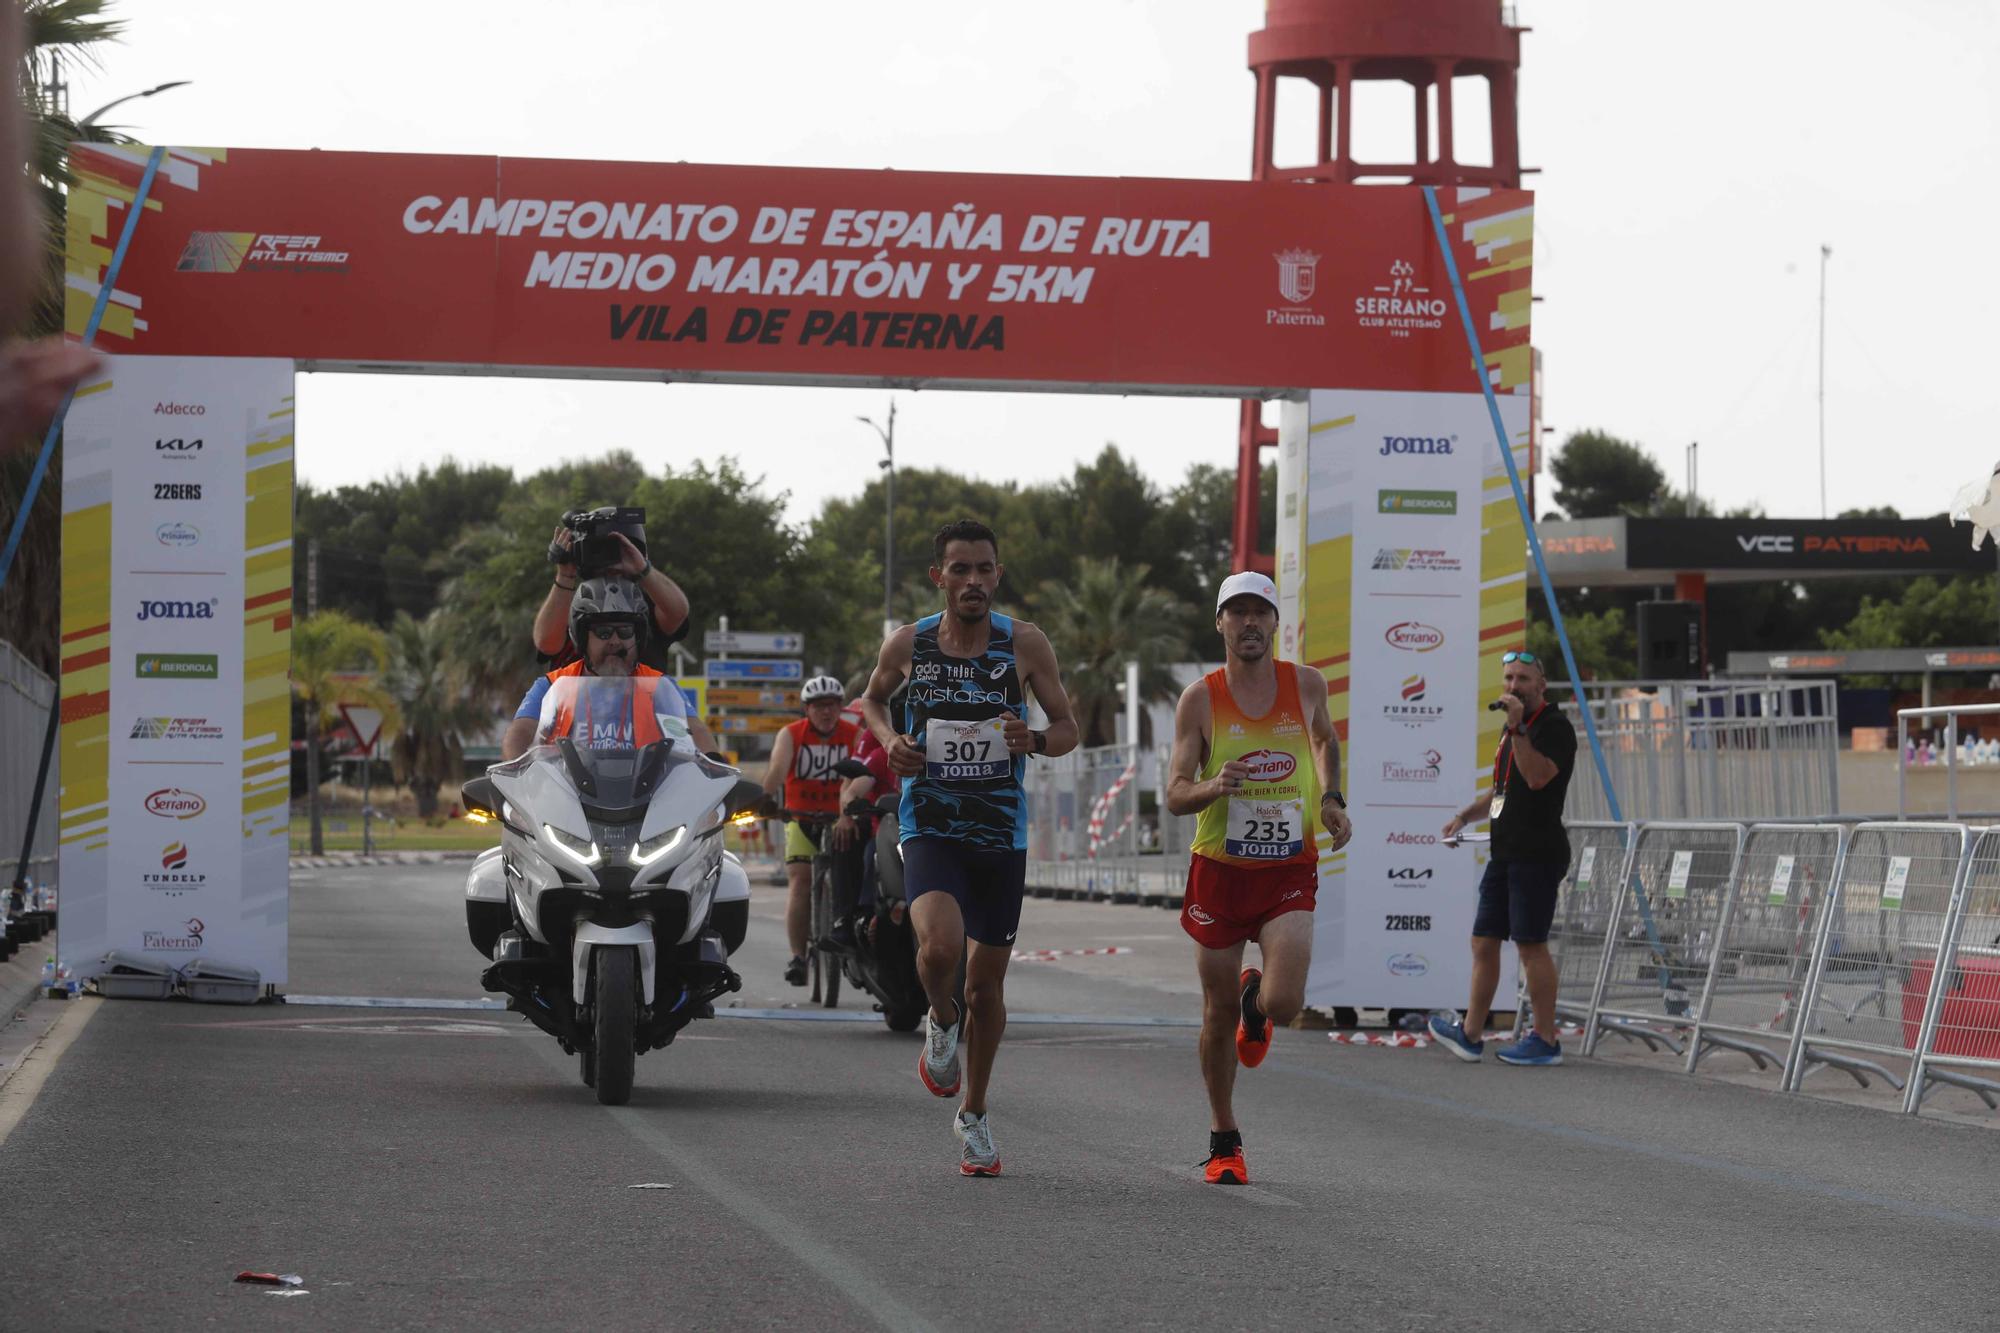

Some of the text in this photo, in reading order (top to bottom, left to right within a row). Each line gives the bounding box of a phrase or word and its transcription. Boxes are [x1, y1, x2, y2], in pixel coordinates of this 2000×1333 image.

[402, 195, 1210, 258] CAMPEONATO DE ESPAÑA DE RUTA
[249, 251, 349, 263] ATLETISMO
[524, 251, 1095, 304] MEDIO MARATÓN Y 5KM
[1355, 297, 1446, 317] SERRANO
[1266, 310, 1325, 326] Paterna
[1359, 317, 1442, 329] CLUB ATLETISMO
[608, 304, 1005, 351] VILA DE PATERNA
[154, 402, 206, 415] Adecco
[156, 439, 203, 450] KIA
[154, 483, 202, 500] 226ERS
[1403, 498, 1453, 509] IBERDROLA
[1736, 535, 1931, 553] VCC PATERNA
[1393, 629, 1438, 644] Serrano
[161, 663, 214, 673] IBERDROLA
[915, 661, 941, 675] ada
[947, 664, 976, 679] TRIBE
[916, 685, 1008, 704] vistasol
[1384, 705, 1443, 714] FUNDELP
[943, 741, 992, 762] 307
[1382, 764, 1438, 779] Paterna
[1272, 787, 1278, 795] Y
[152, 796, 200, 811] Serrano
[1244, 820, 1290, 842] 235
[1386, 832, 1436, 845] Adecco
[1388, 868, 1433, 879] KIA
[1385, 915, 1432, 931] 226ERS
[143, 935, 200, 948] Paterna
